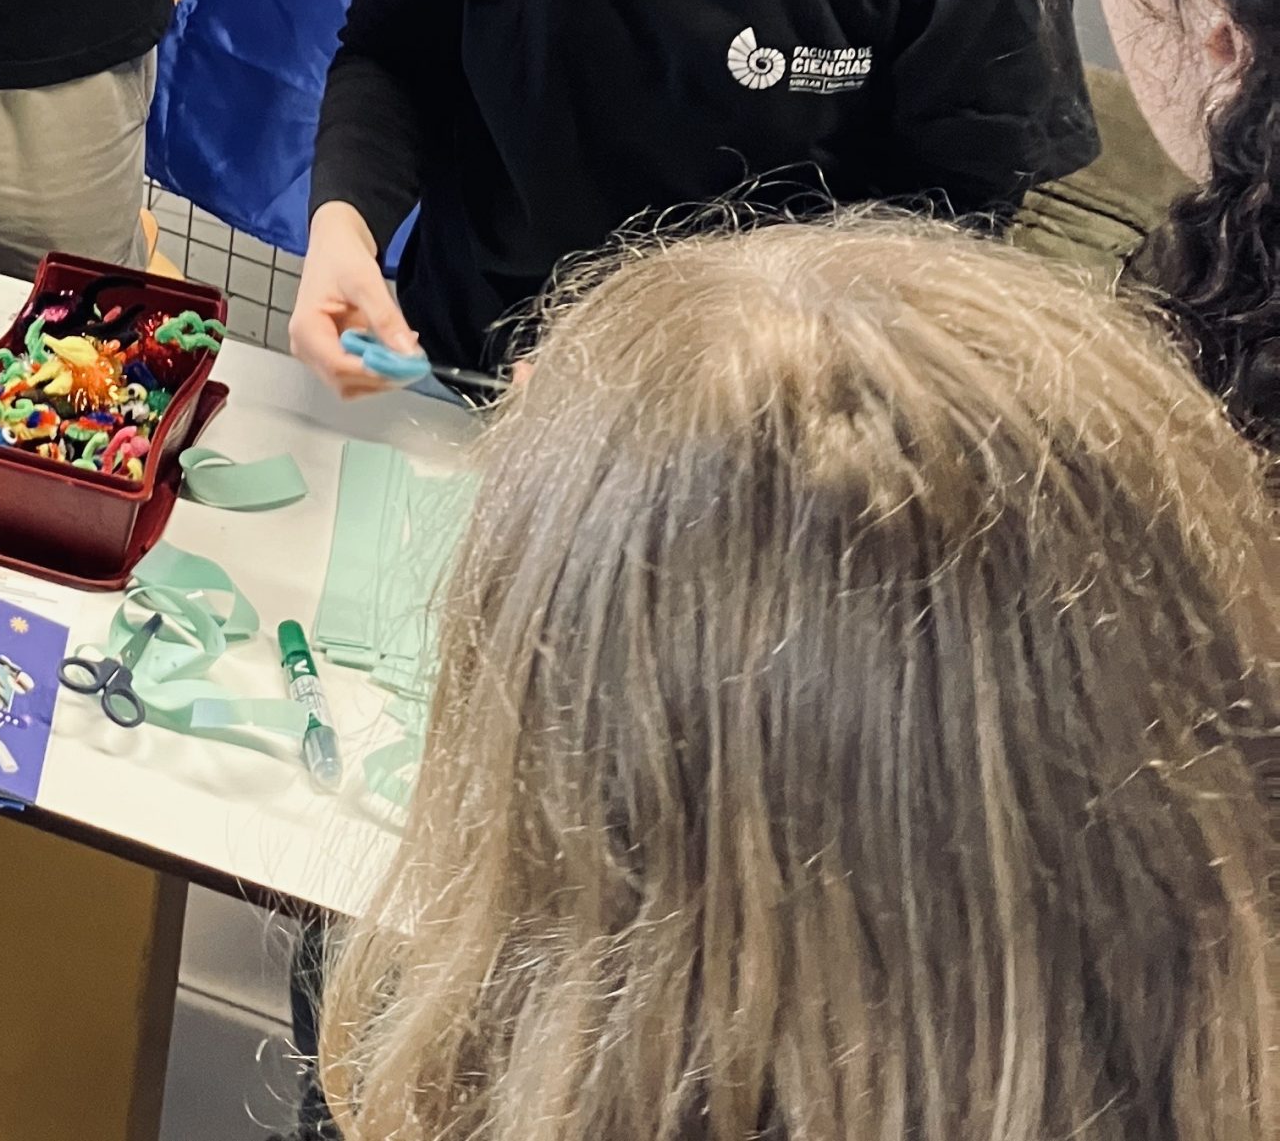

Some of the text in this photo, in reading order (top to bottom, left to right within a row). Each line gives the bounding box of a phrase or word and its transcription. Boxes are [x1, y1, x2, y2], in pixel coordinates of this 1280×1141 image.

[793, 45, 873, 61] FACULTAD DE
[790, 57, 872, 76] CIENCIAS
